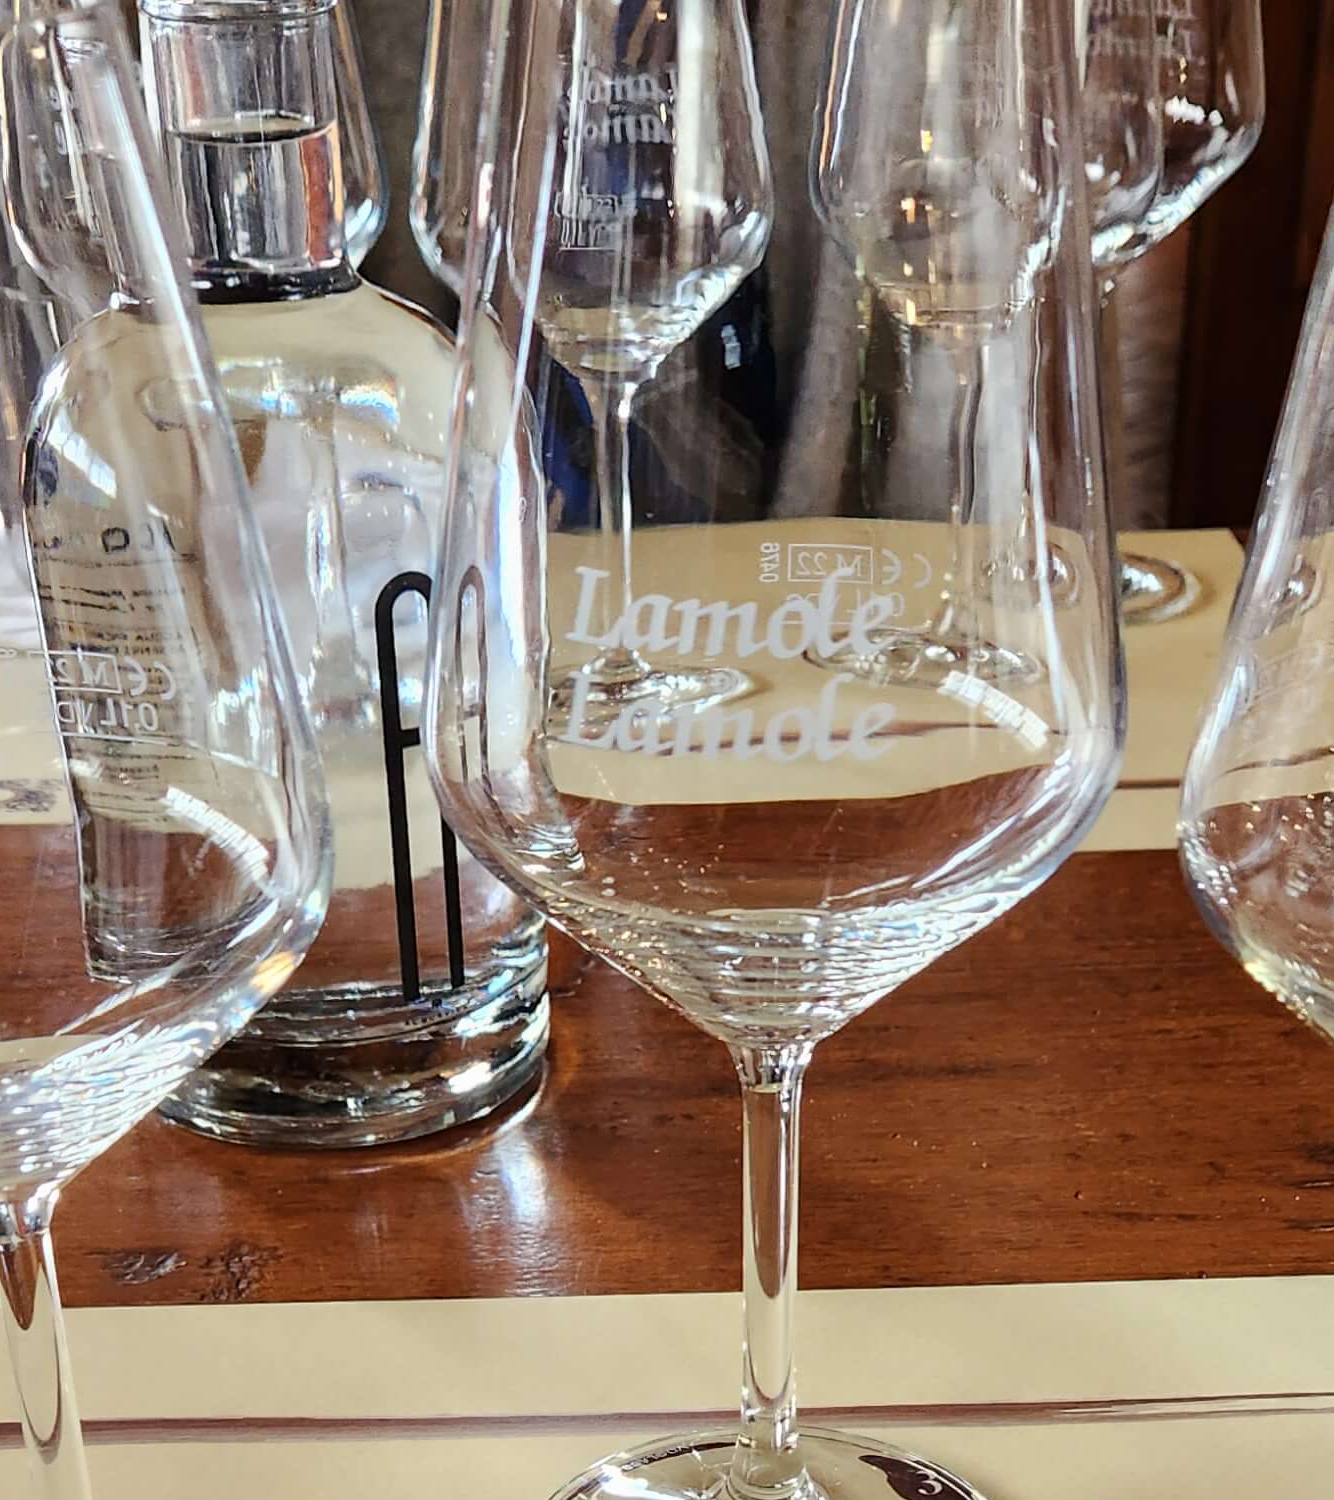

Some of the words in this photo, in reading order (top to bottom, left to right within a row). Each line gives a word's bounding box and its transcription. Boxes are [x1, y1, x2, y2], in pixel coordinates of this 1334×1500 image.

[566, 566, 896, 661] Lamole
[566, 670, 896, 764] Lamole
[915, 1470, 943, 1496] 3
